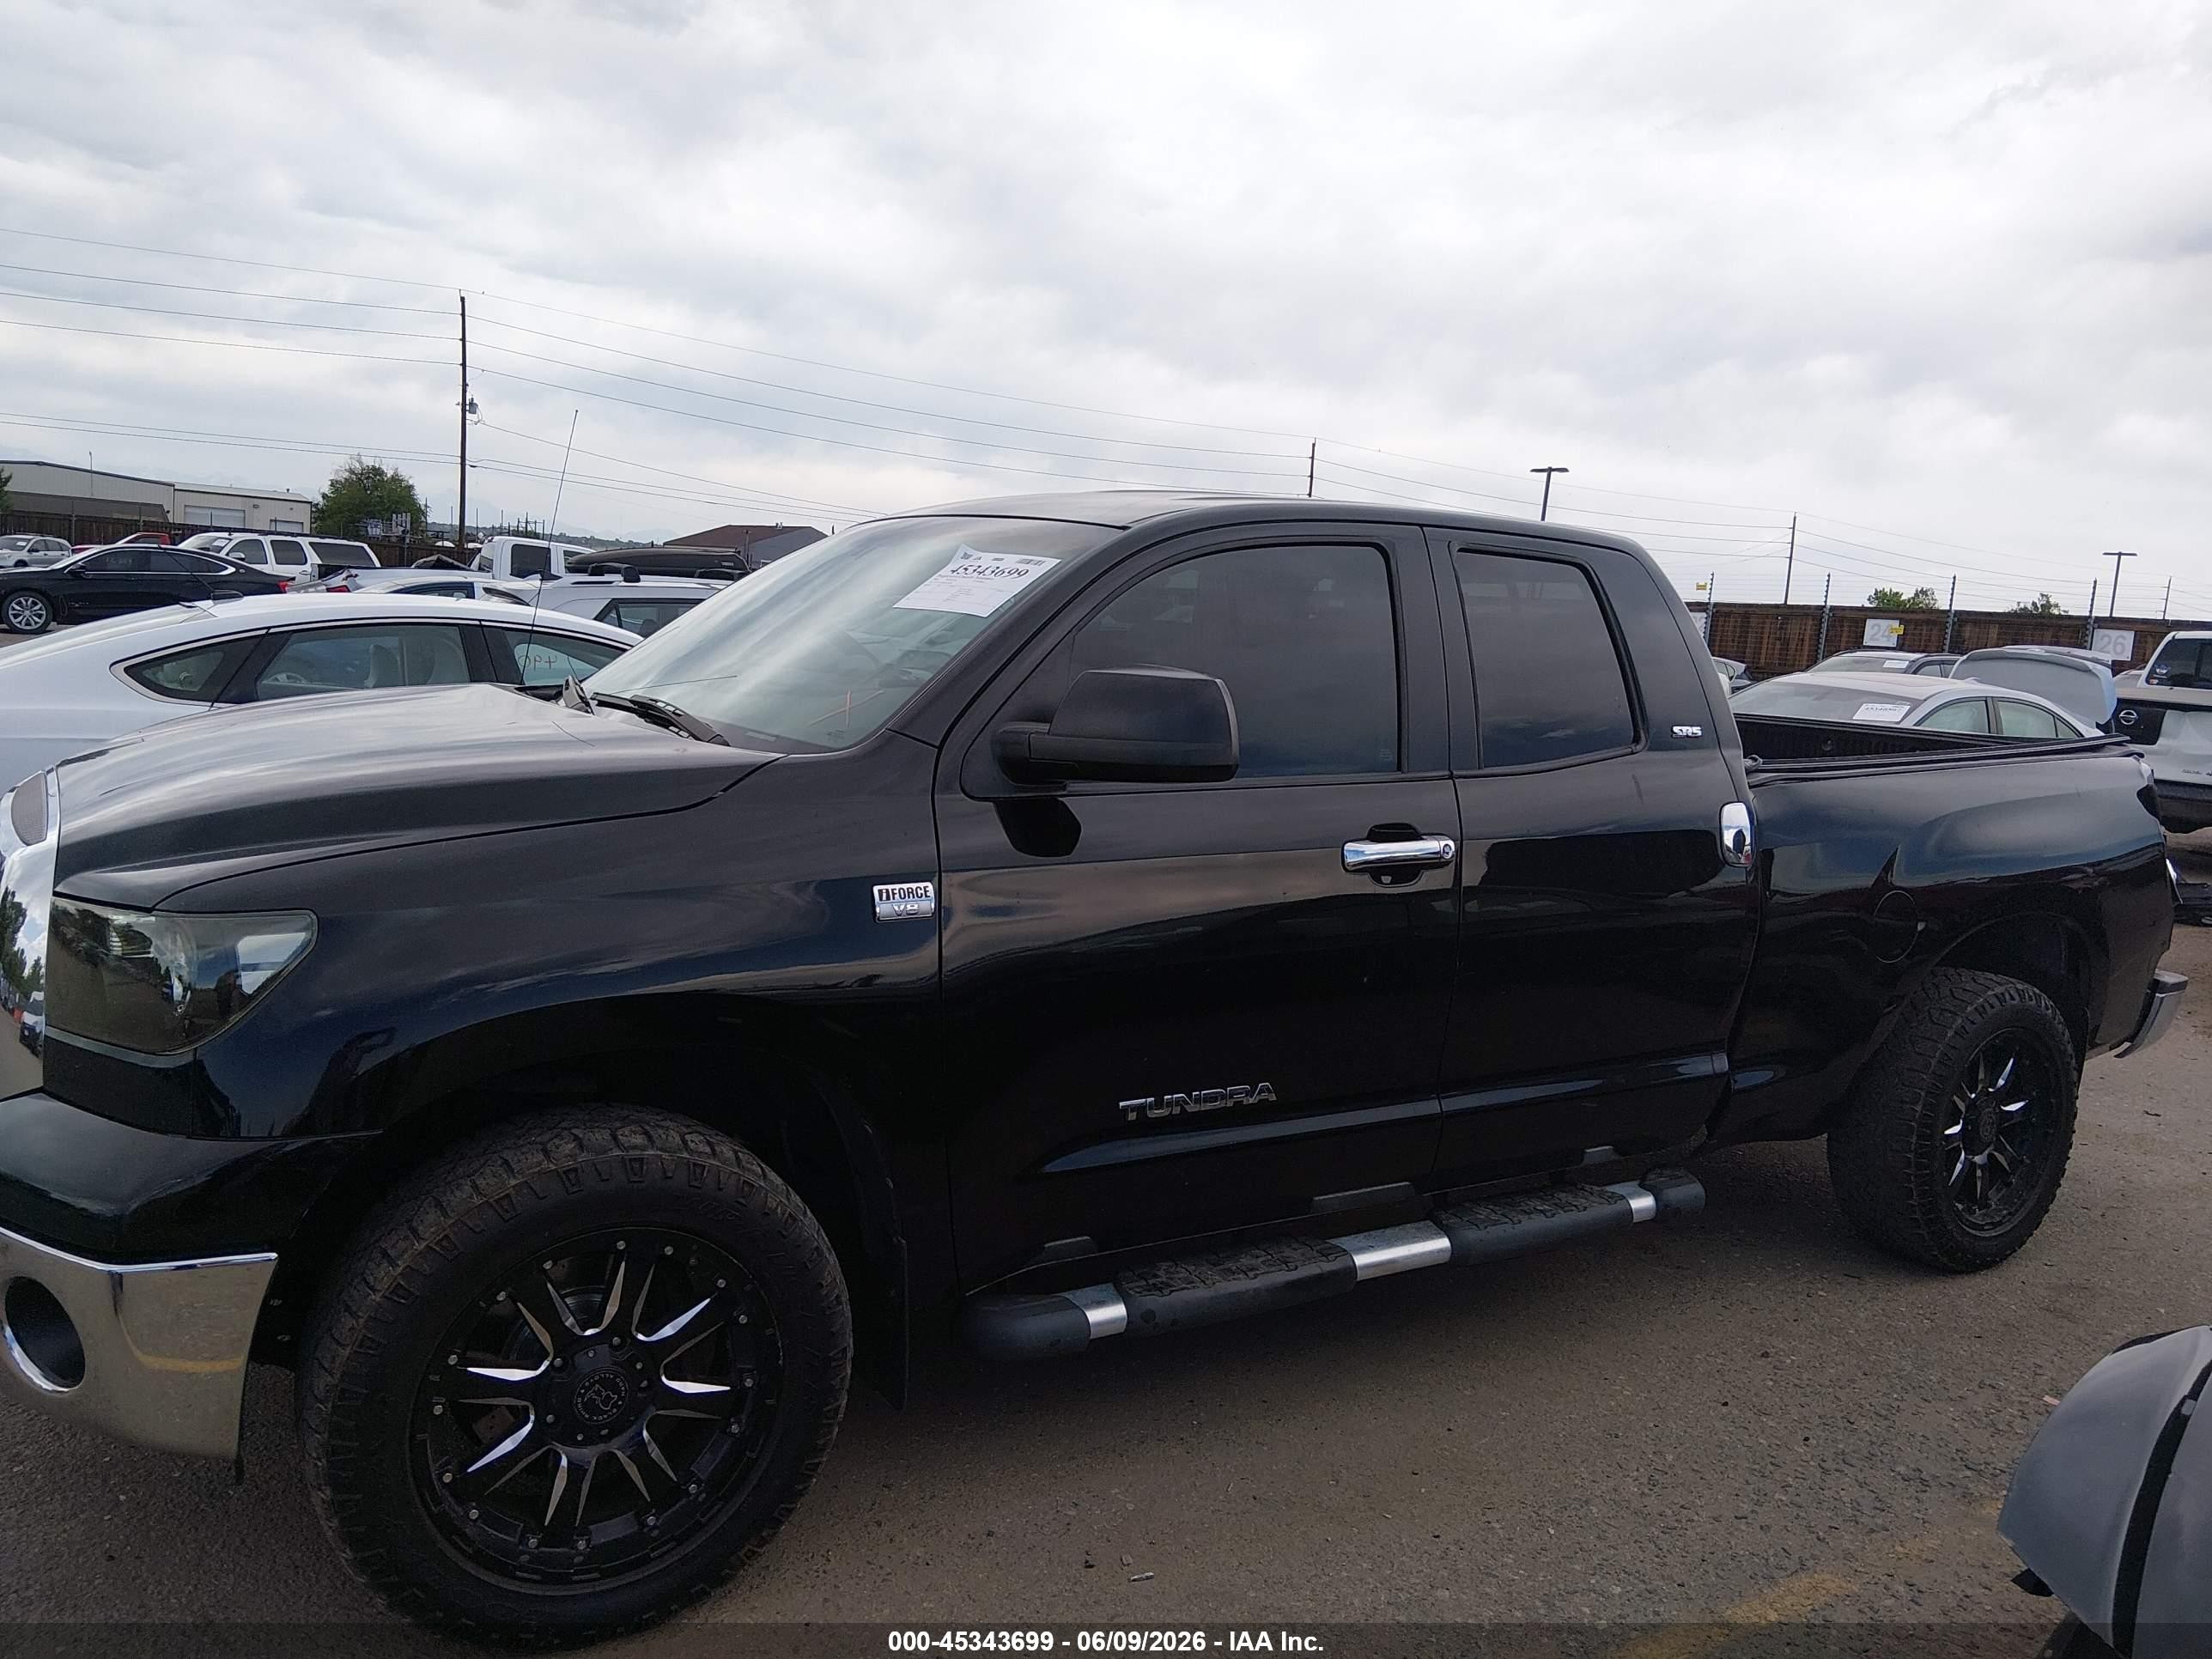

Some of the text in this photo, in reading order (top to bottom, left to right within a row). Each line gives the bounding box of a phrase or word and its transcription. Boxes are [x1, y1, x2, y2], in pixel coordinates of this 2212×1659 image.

[951, 564, 1030, 580] 45343699
[2096, 633, 2127, 655] 26
[1672, 726, 1703, 738] SR5
[892, 903, 920, 917] V8
[1119, 1082, 1278, 1121] TUNDRA
